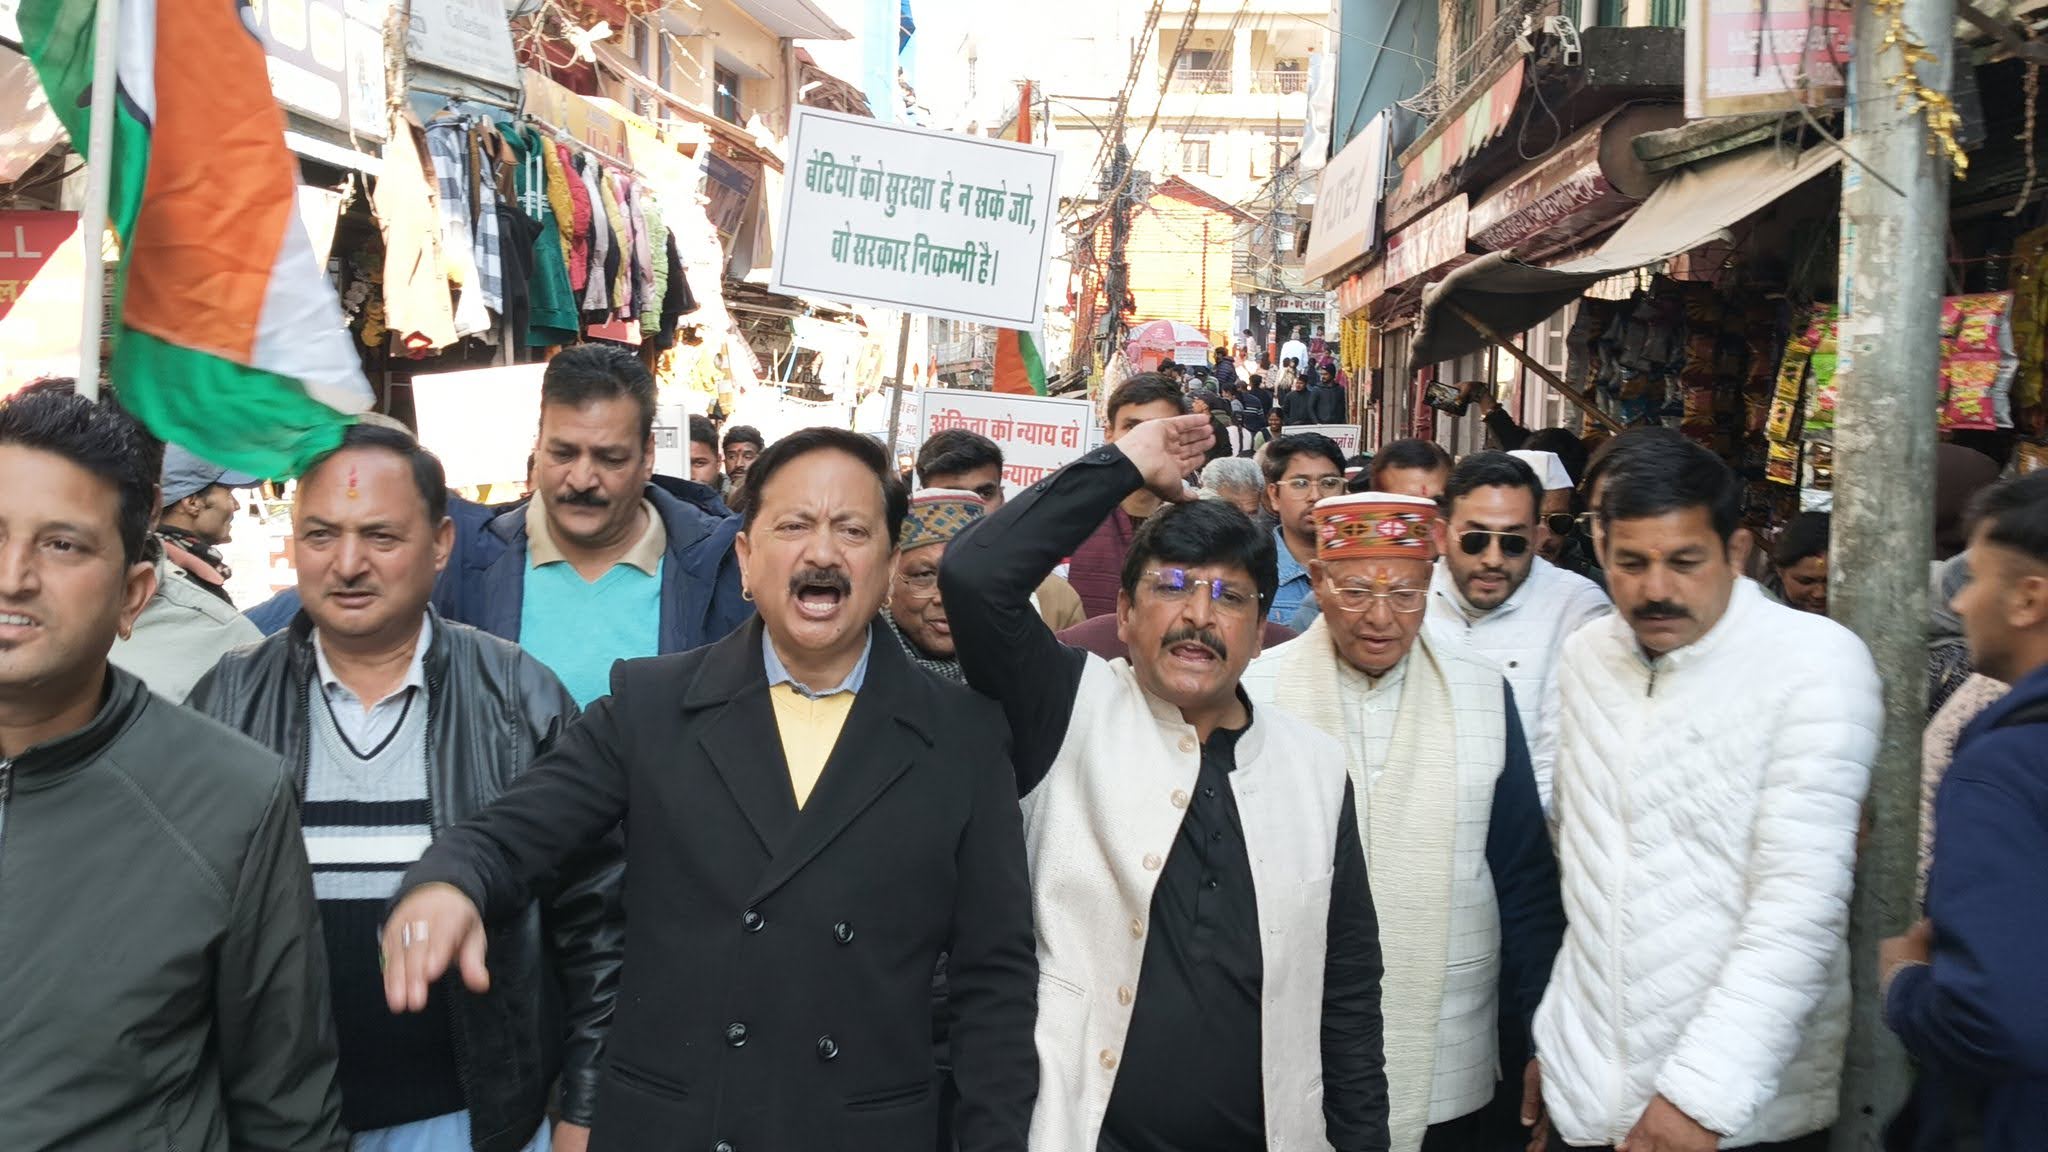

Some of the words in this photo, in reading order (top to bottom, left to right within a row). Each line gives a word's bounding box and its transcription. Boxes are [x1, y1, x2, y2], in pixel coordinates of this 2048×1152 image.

[859, 159, 884, 202] को
[884, 172, 935, 218] सुरक्षा
[939, 170, 954, 213] दे
[958, 183, 974, 216] न
[975, 180, 1007, 221] सके
[1008, 183, 1037, 234] जो,
[831, 221, 852, 263] वो
[852, 233, 911, 272] सरकार
[911, 233, 978, 282] निकम्मी
[991, 413, 1014, 442] को
[1016, 421, 1058, 446] न्याय
[1061, 419, 1080, 449] दो
